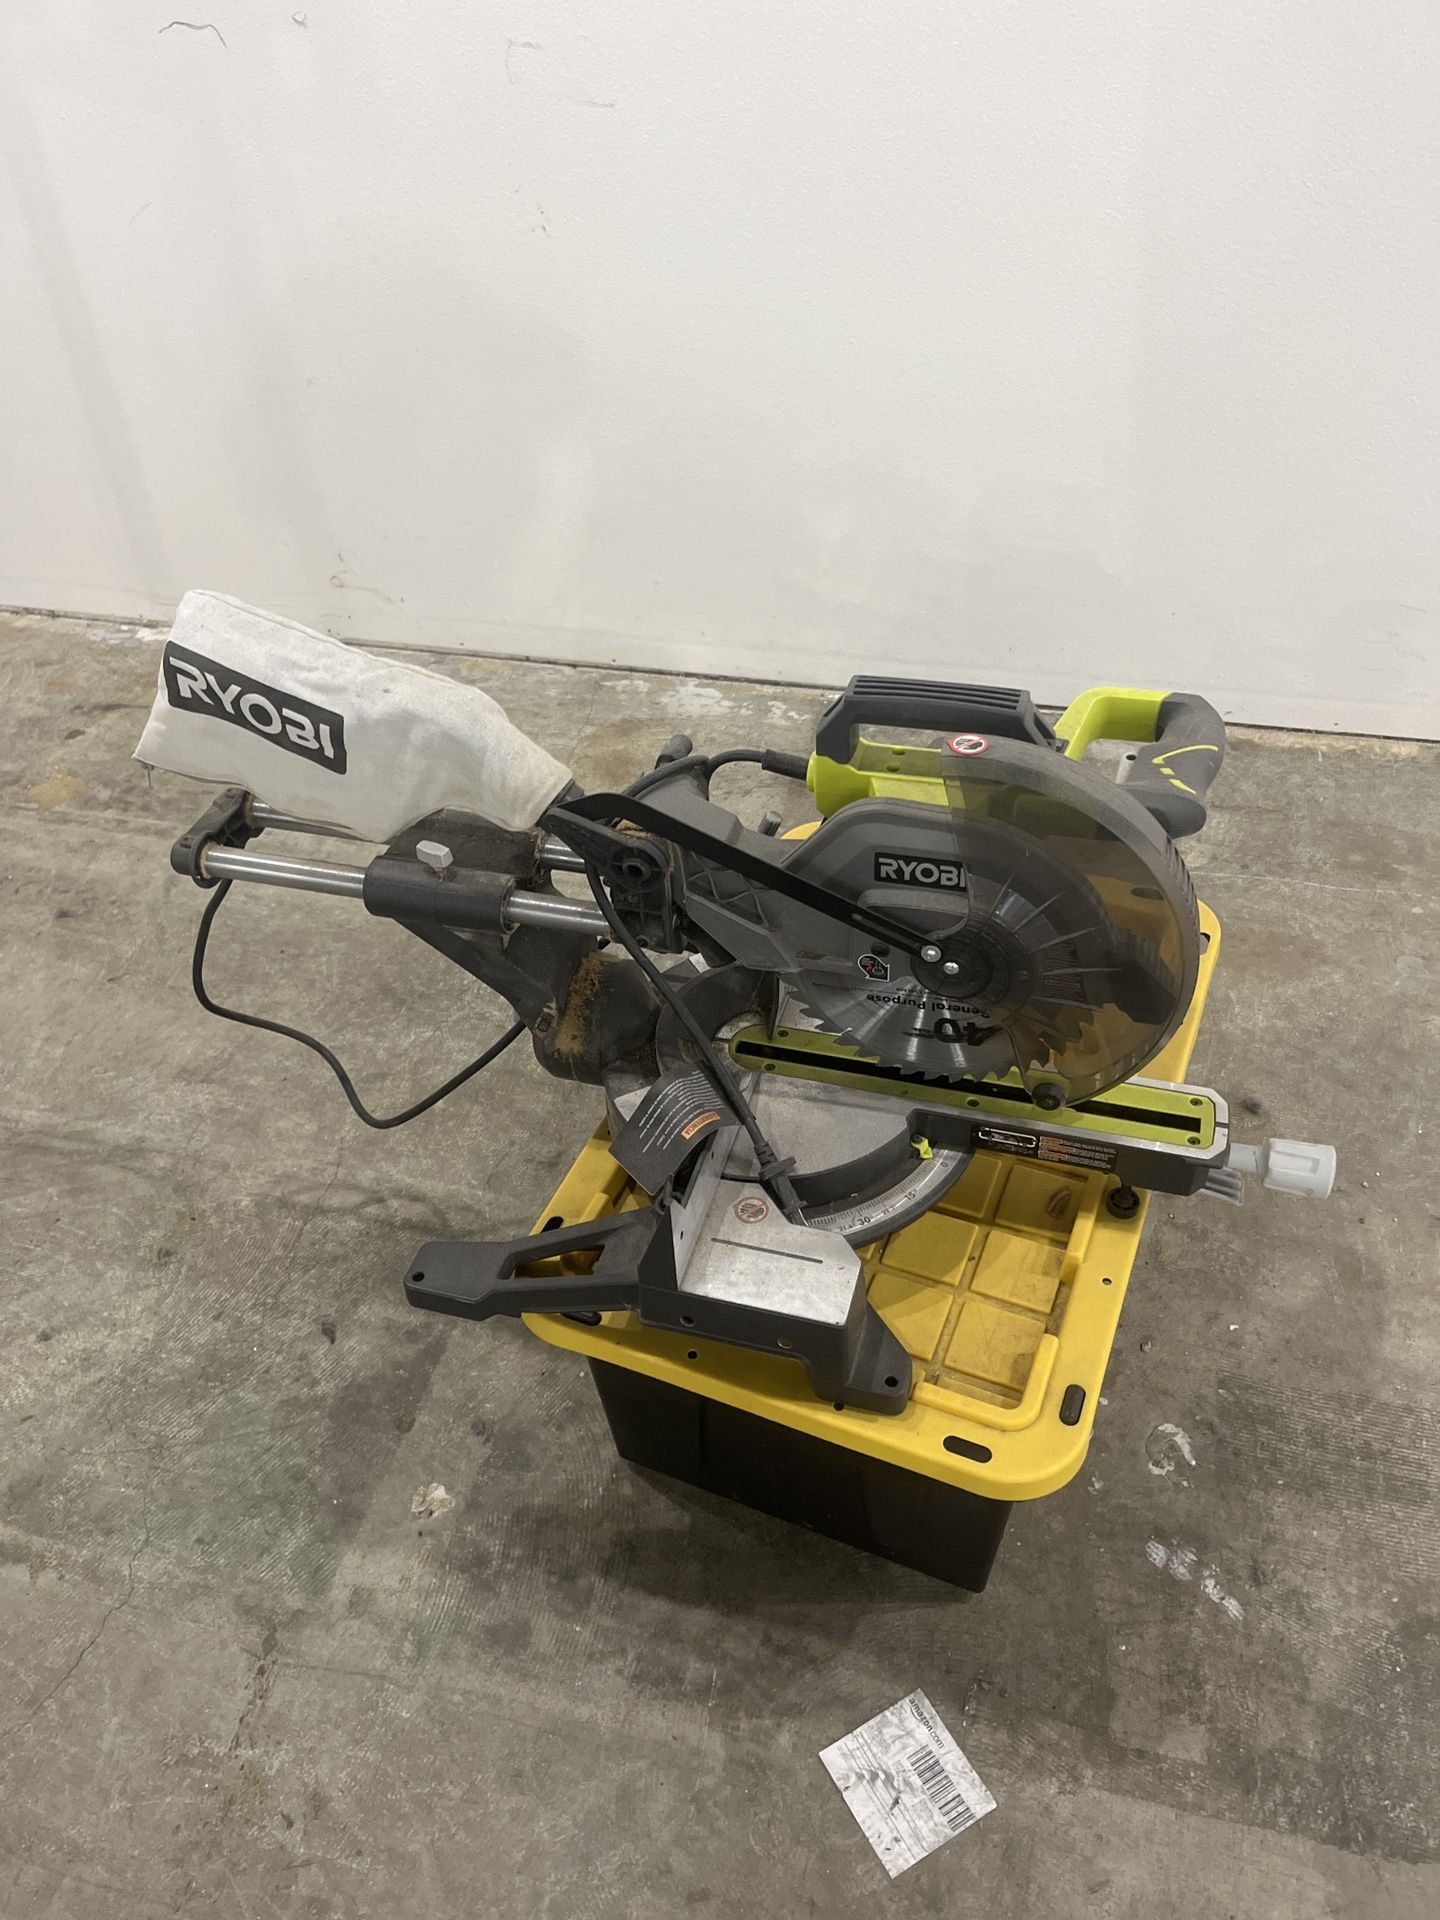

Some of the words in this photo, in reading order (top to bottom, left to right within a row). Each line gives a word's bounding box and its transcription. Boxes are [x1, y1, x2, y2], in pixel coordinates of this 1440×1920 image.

[169, 656, 335, 759] RYOBI
[878, 857, 966, 888] RYOBI
[867, 993, 926, 1010] Purpose
[931, 1002, 991, 1019] General
